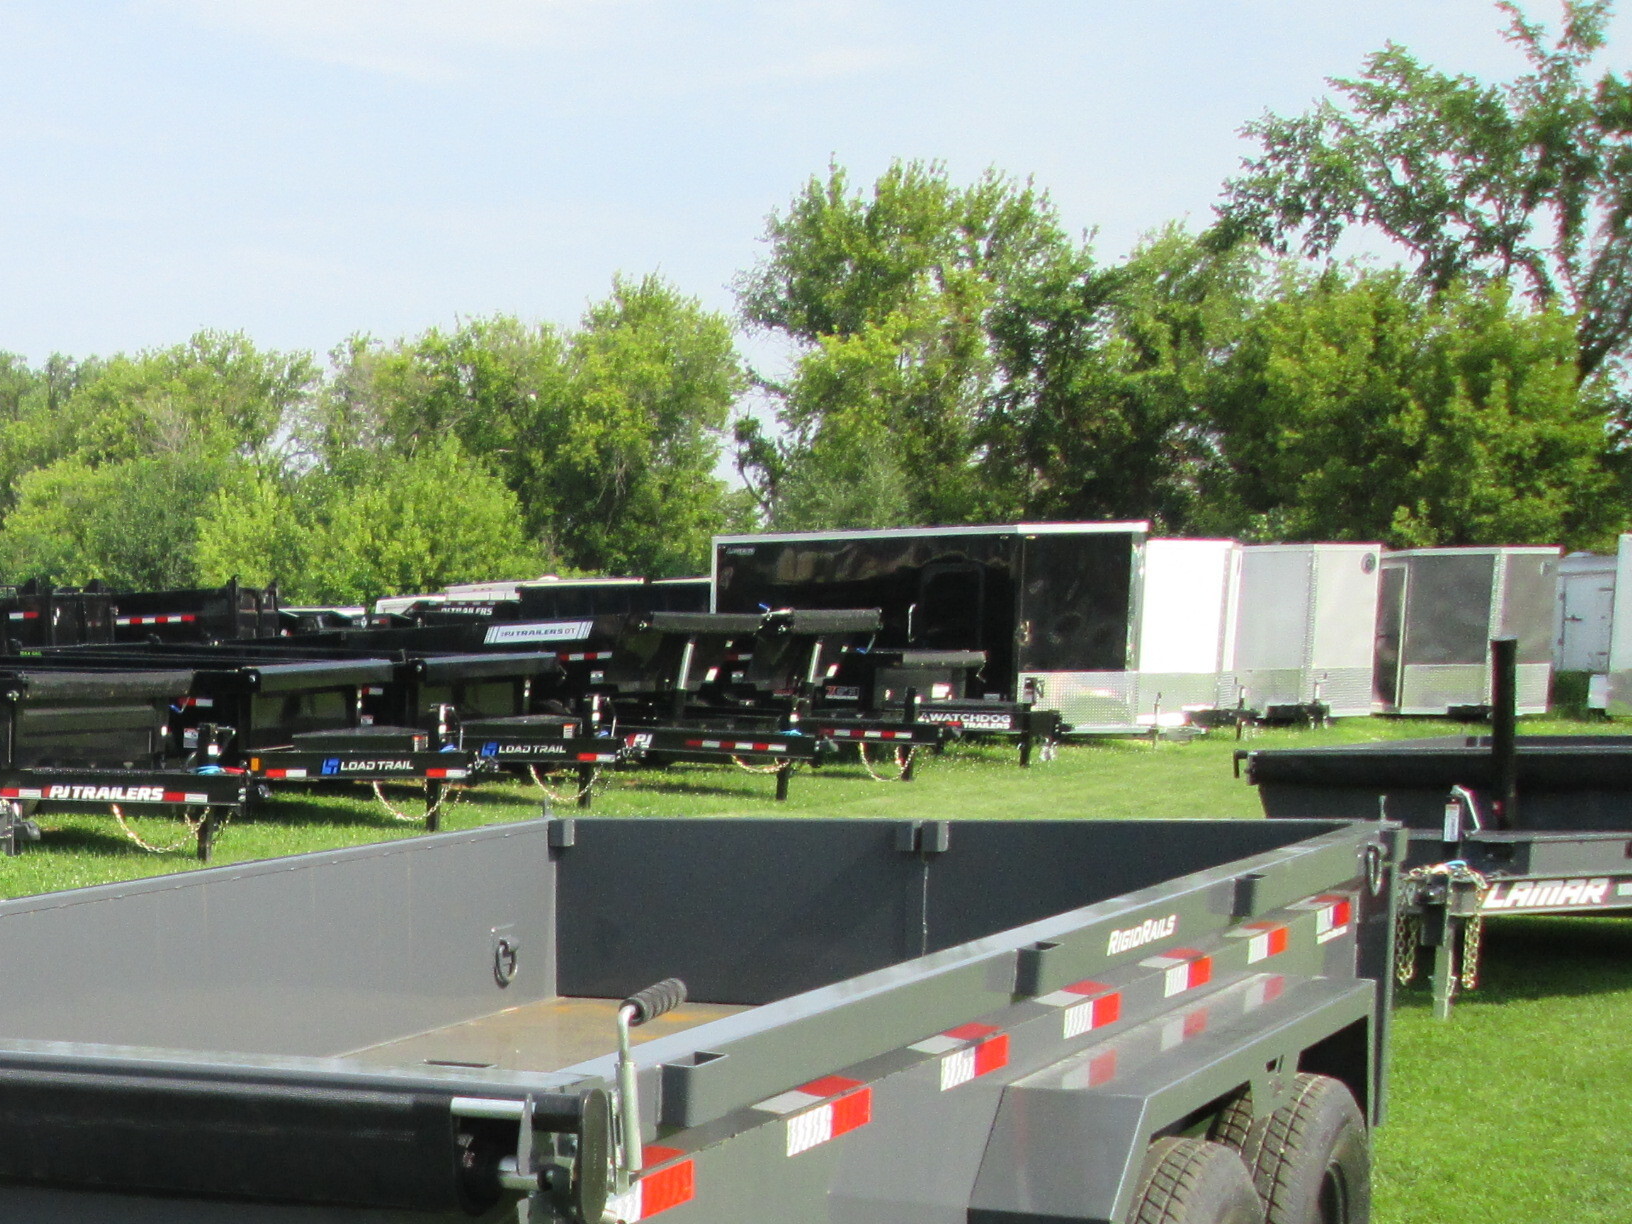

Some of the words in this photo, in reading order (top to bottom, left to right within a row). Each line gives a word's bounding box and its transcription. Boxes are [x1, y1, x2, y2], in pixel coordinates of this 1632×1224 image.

[929, 713, 1011, 723] WATCHDOG
[963, 721, 1010, 729] TRAILERS
[498, 745, 531, 753] LOAD
[533, 744, 567, 753] TRAIL
[340, 761, 376, 771] LOAD
[377, 760, 414, 770] TRAIL
[71, 786, 164, 801] TRAILERS
[1482, 878, 1610, 908] LAMAR
